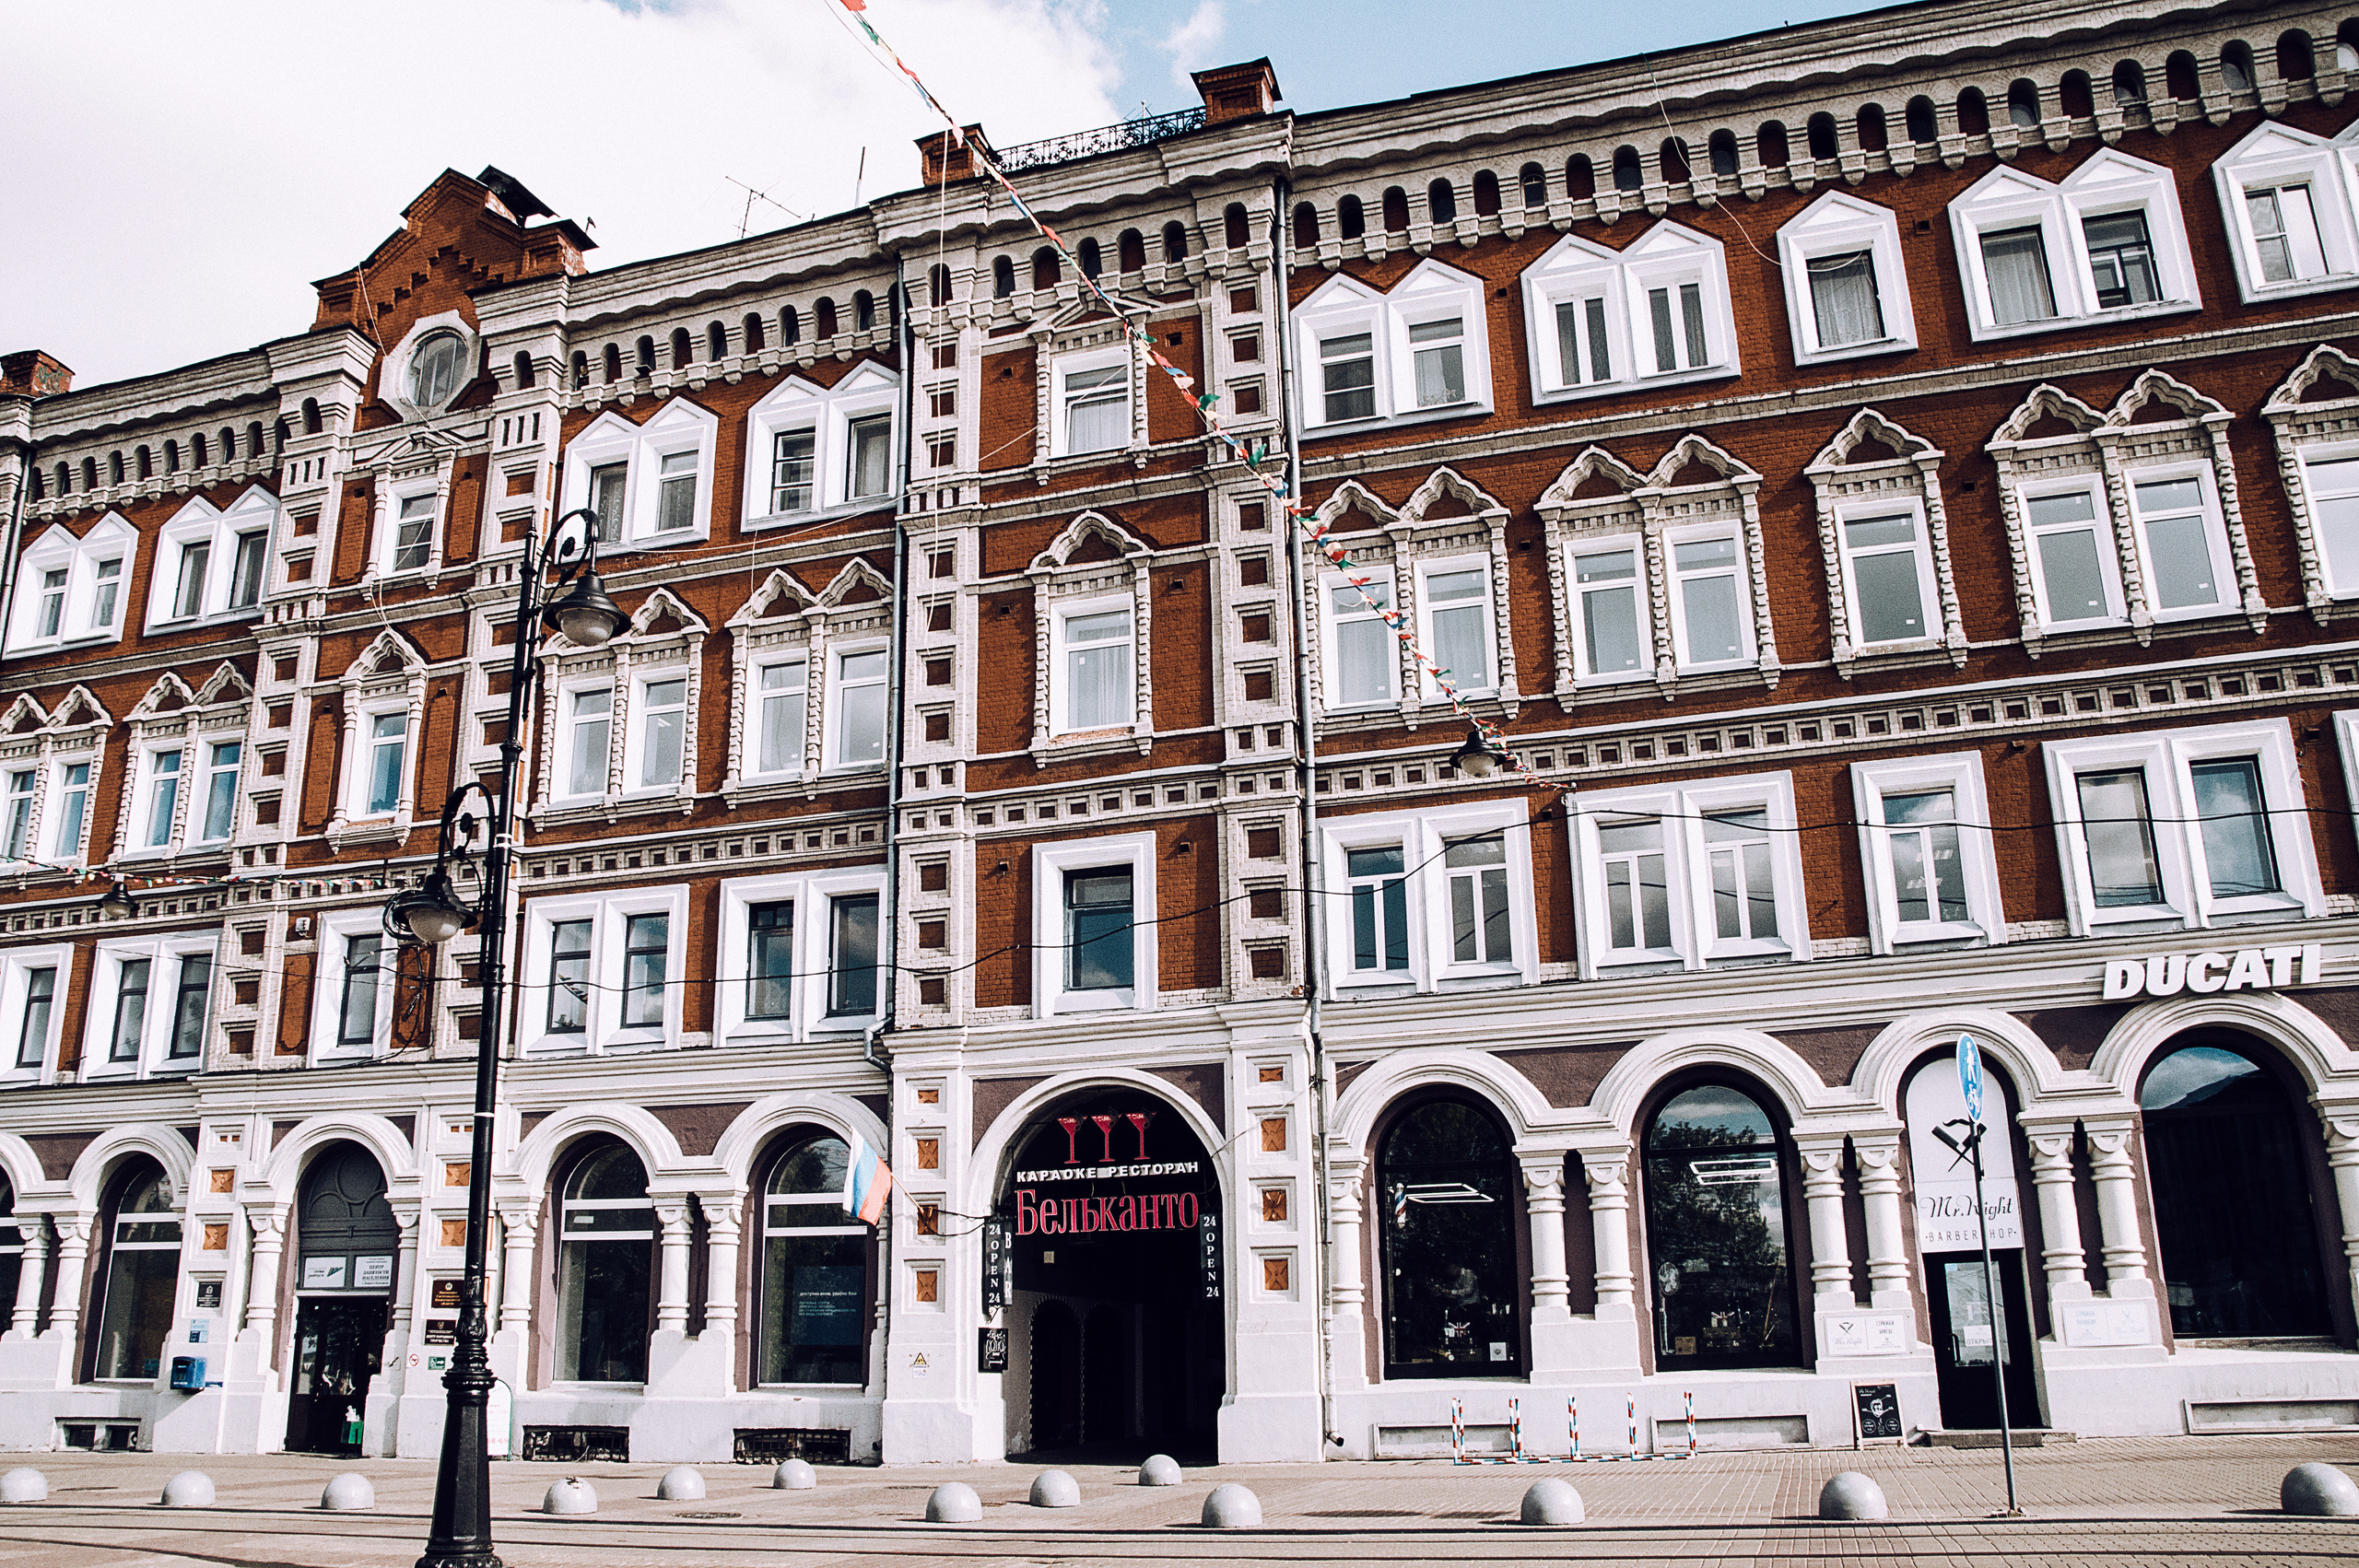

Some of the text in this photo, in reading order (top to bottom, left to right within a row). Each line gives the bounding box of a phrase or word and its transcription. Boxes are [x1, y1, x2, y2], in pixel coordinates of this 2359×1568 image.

[2103, 943, 2321, 1000] DUCATI
[1016, 1161, 1198, 1182] КАРАОКЕ РЕСТОРАН
[1015, 1189, 1199, 1235] Бельканто
[1928, 1227, 2013, 1243] BARBERHOP
[989, 1224, 1001, 1304] 24 OPEN 24
[1004, 1232, 1013, 1298] BAR
[1203, 1216, 1219, 1297] 24 OPEN 24
